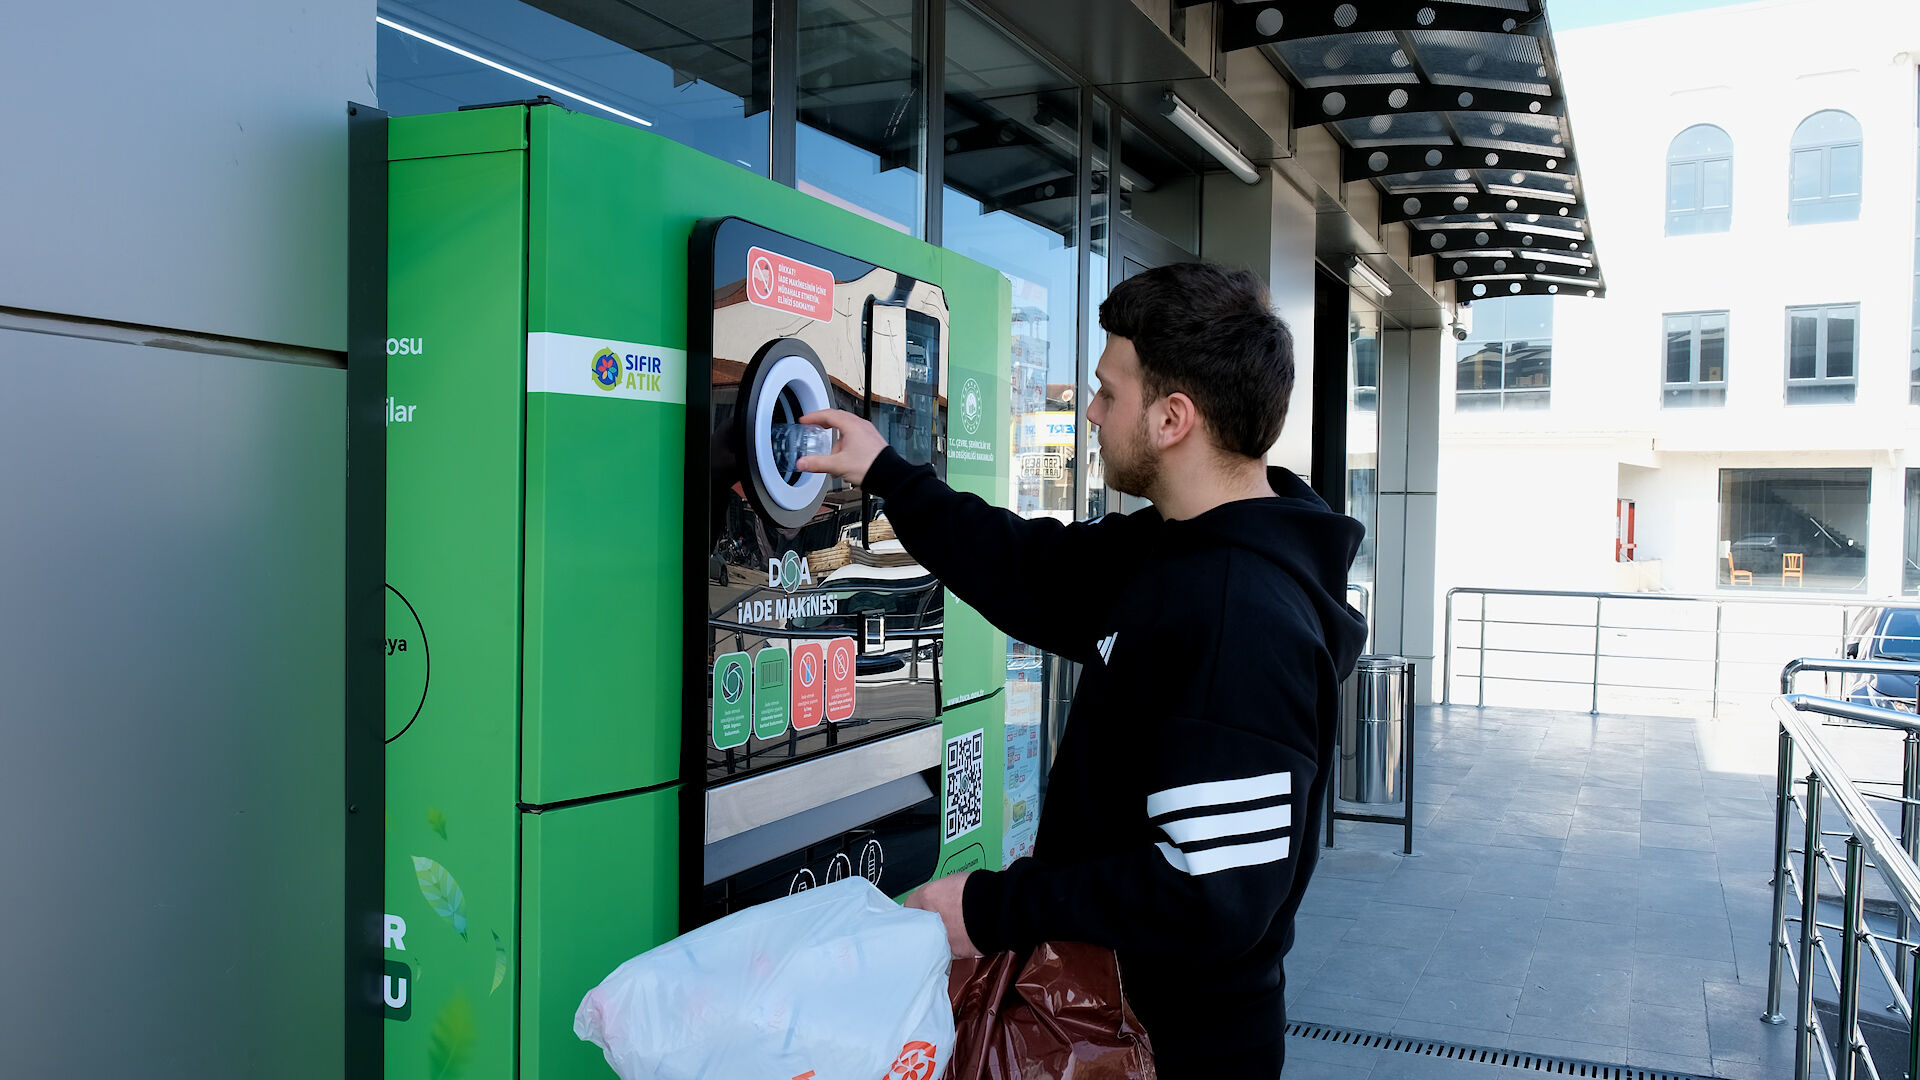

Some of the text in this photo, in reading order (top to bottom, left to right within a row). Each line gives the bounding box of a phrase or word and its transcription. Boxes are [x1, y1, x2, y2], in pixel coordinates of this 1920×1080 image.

[386, 337, 423, 355] osu
[625, 354, 661, 373] SIFIR
[626, 372, 661, 392] ATIK
[384, 638, 407, 656] ya
